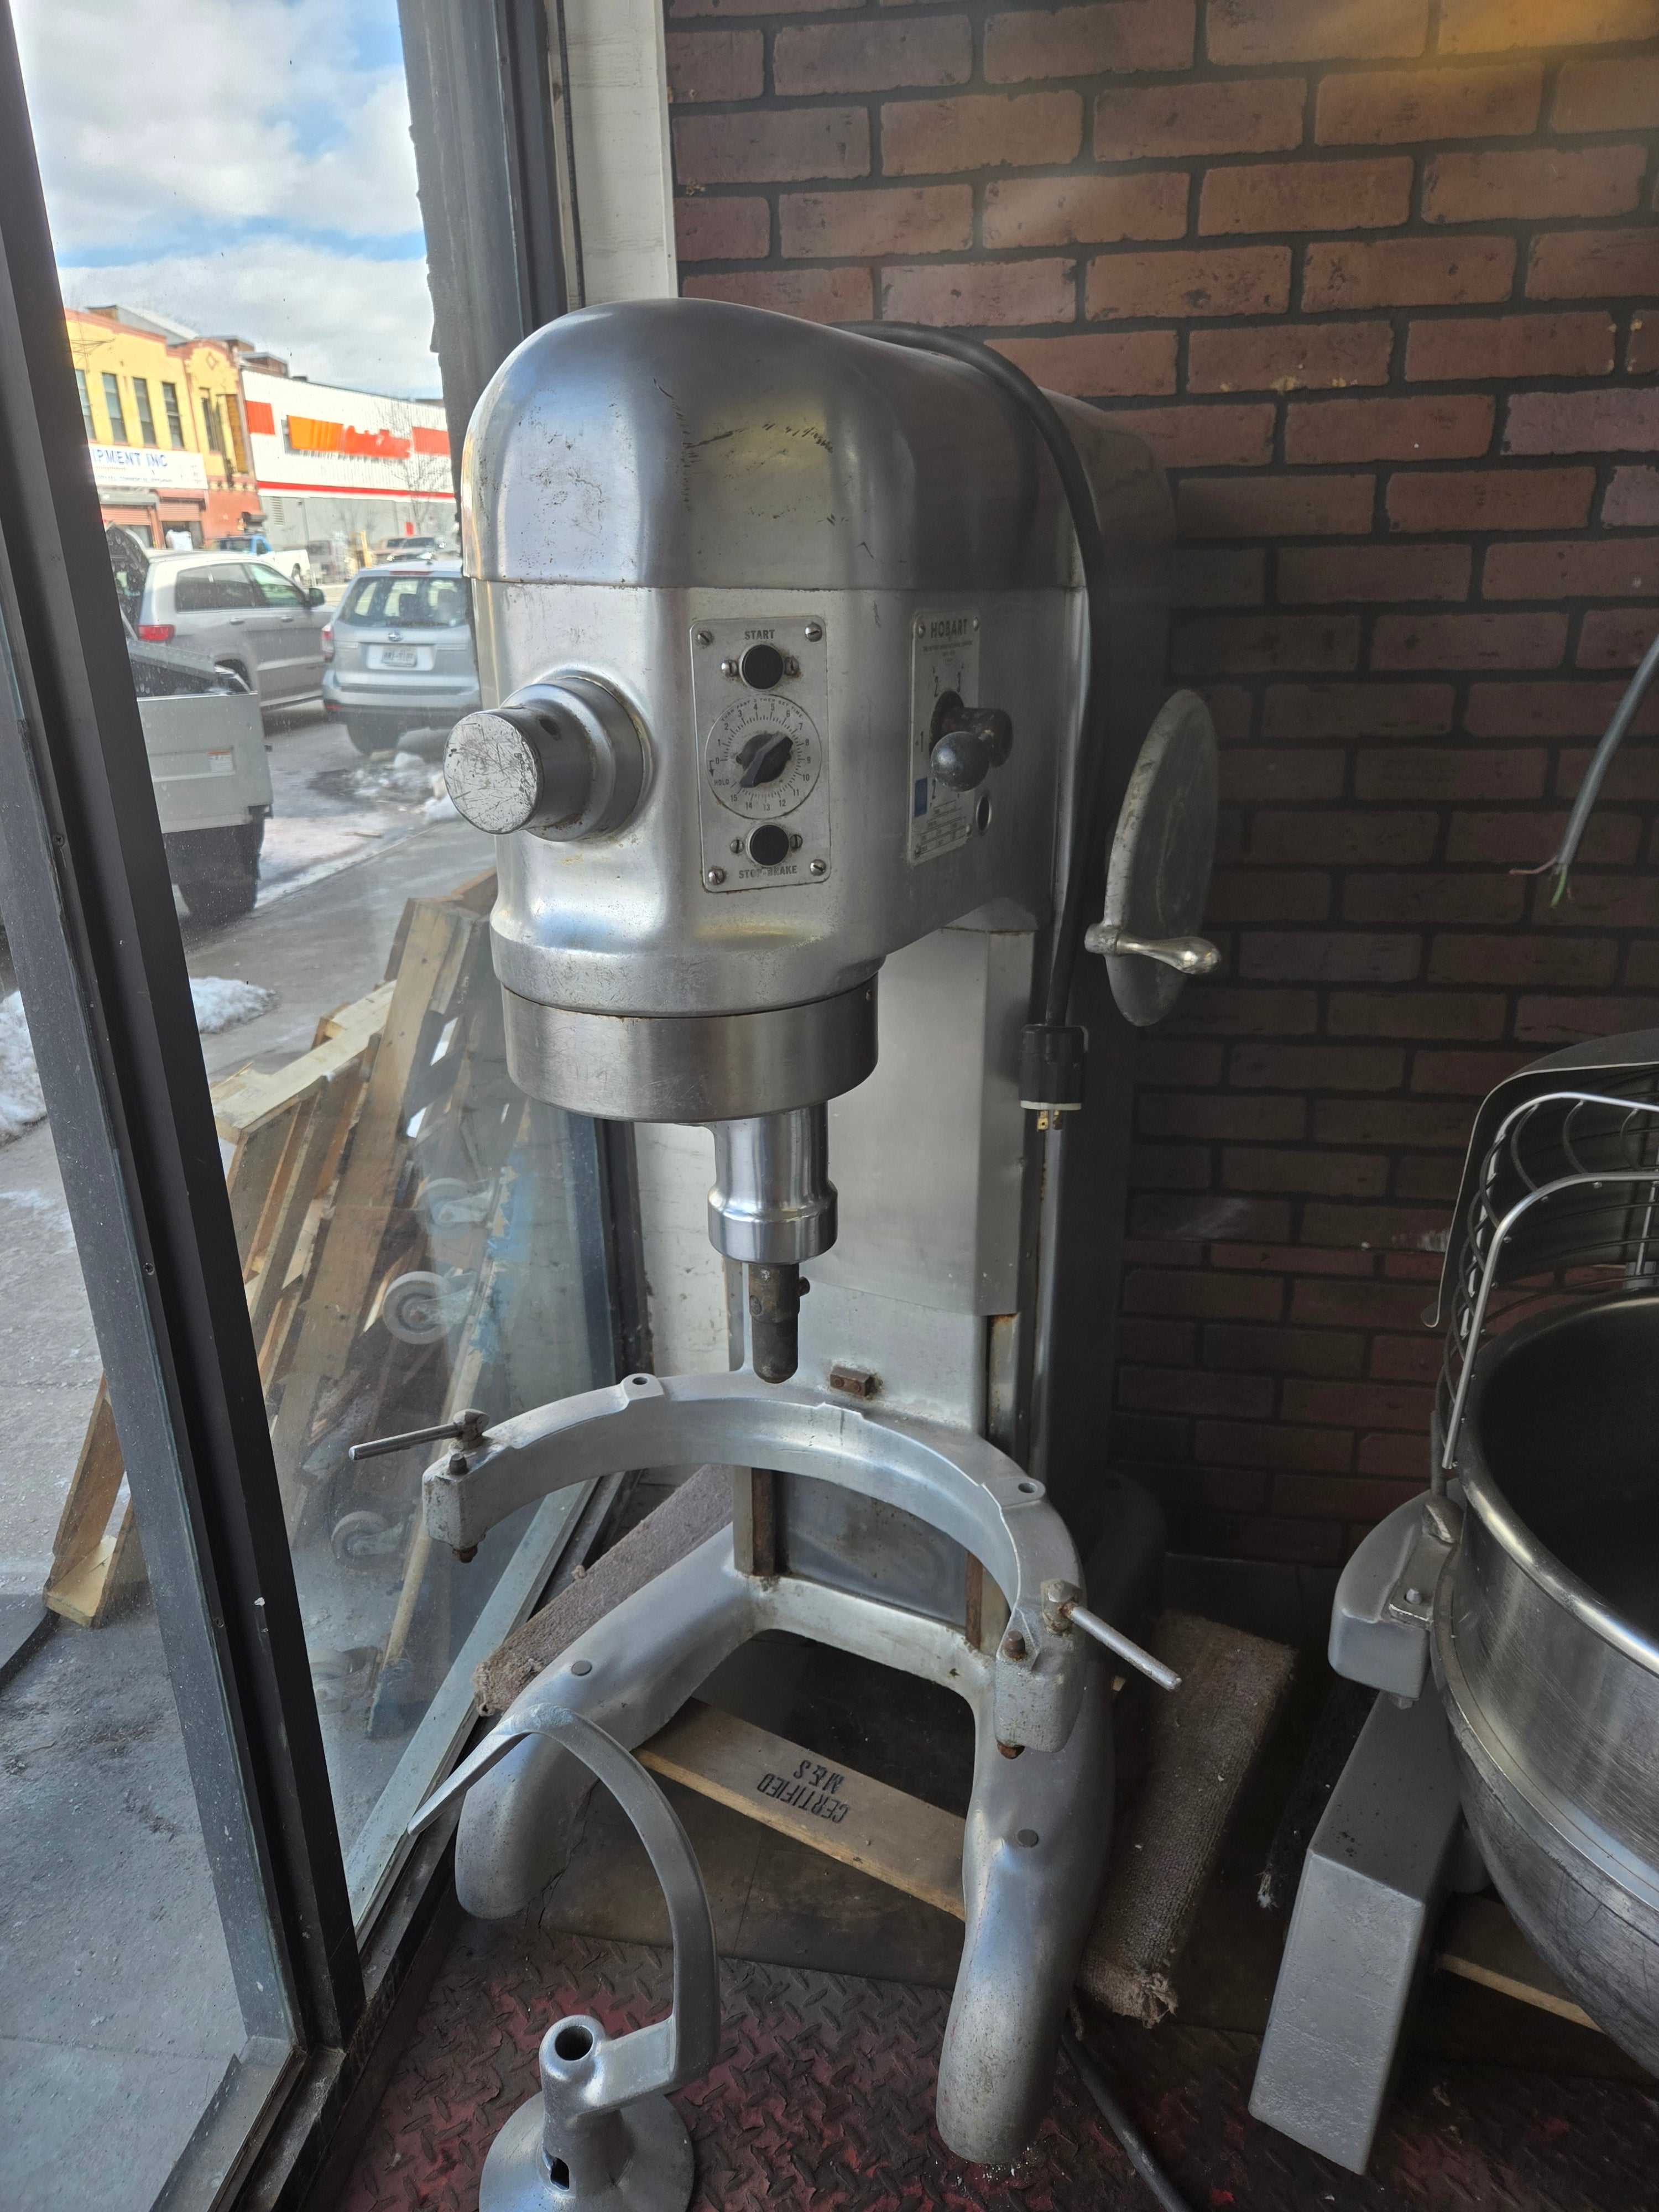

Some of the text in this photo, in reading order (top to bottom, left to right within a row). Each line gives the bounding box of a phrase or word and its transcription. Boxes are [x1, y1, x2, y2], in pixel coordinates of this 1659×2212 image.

[145, 453, 168, 467] INC
[744, 629, 775, 640] START
[930, 618, 968, 639] HOBART
[721, 709, 734, 722] TURN
[737, 701, 750, 709] PAST
[738, 865, 797, 879] STOP-BRAKE
[757, 1773, 850, 1824] CERTIFIED
